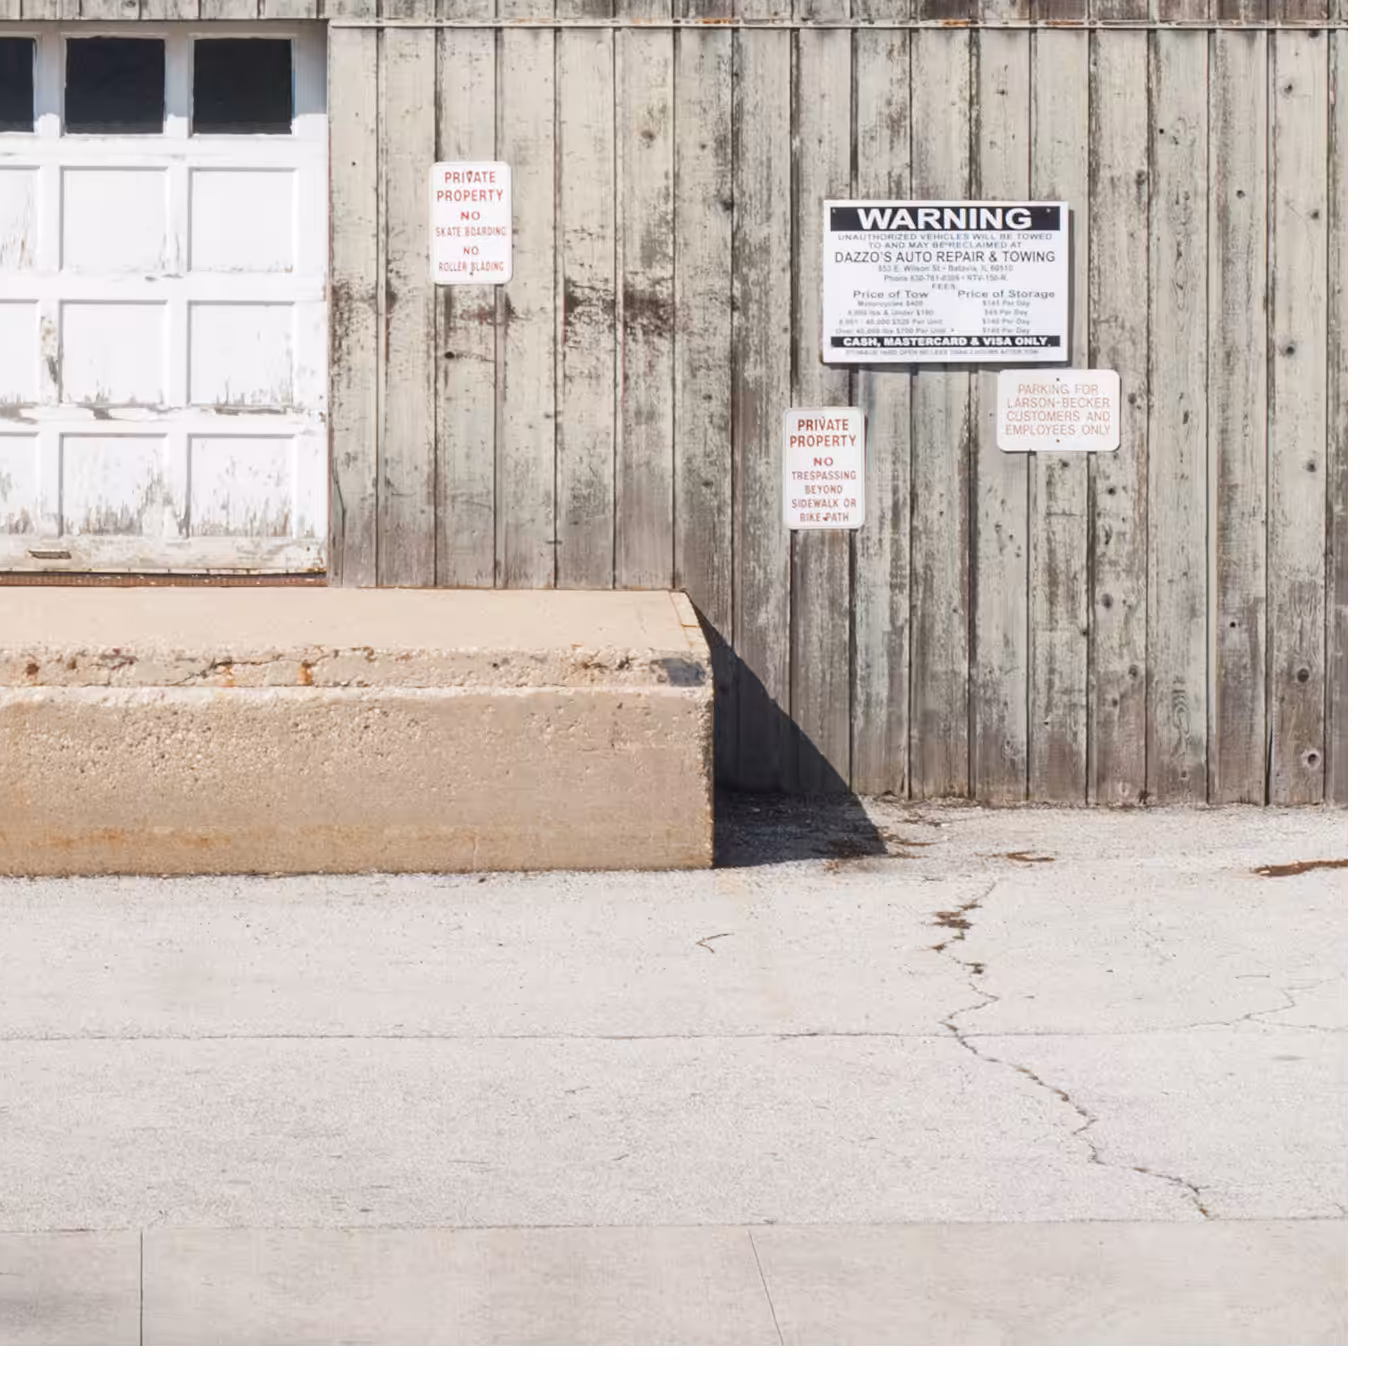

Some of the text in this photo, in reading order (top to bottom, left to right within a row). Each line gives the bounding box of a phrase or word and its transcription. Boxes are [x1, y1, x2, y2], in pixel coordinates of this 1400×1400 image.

[444, 171, 496, 183] PRIVATE
[437, 189, 503, 201] PROPERTY
[460, 211, 481, 221] NO
[857, 208, 1032, 230] WARNING
[435, 227, 506, 237] SKATE BOARDING
[463, 246, 479, 255] NO
[835, 251, 1056, 263] DAZZO'S AUTO REPAIR & TOWING
[439, 262, 504, 272] ROLLER BLADING
[853, 290, 929, 298] Price of Tow
[958, 289, 1055, 299] Price of Storage
[843, 337, 1048, 347] CASH, MASTERCARD & VISA ONLY
[1018, 383, 1098, 395] PARKING FOR
[1007, 397, 1110, 409] LARSON-BECKER
[1006, 410, 1111, 421] CUSTOMERS AND
[797, 419, 849, 431] PRIVATE
[1005, 424, 1111, 435] EMPLOYEES ONLY
[790, 435, 856, 447] PROPERTY
[813, 457, 833, 466] NO
[792, 471, 856, 480] TRESPASSING
[805, 485, 843, 494] BEYOND
[791, 499, 856, 508] SIDEWALK OR
[800, 513, 849, 522] BIKE PATH
